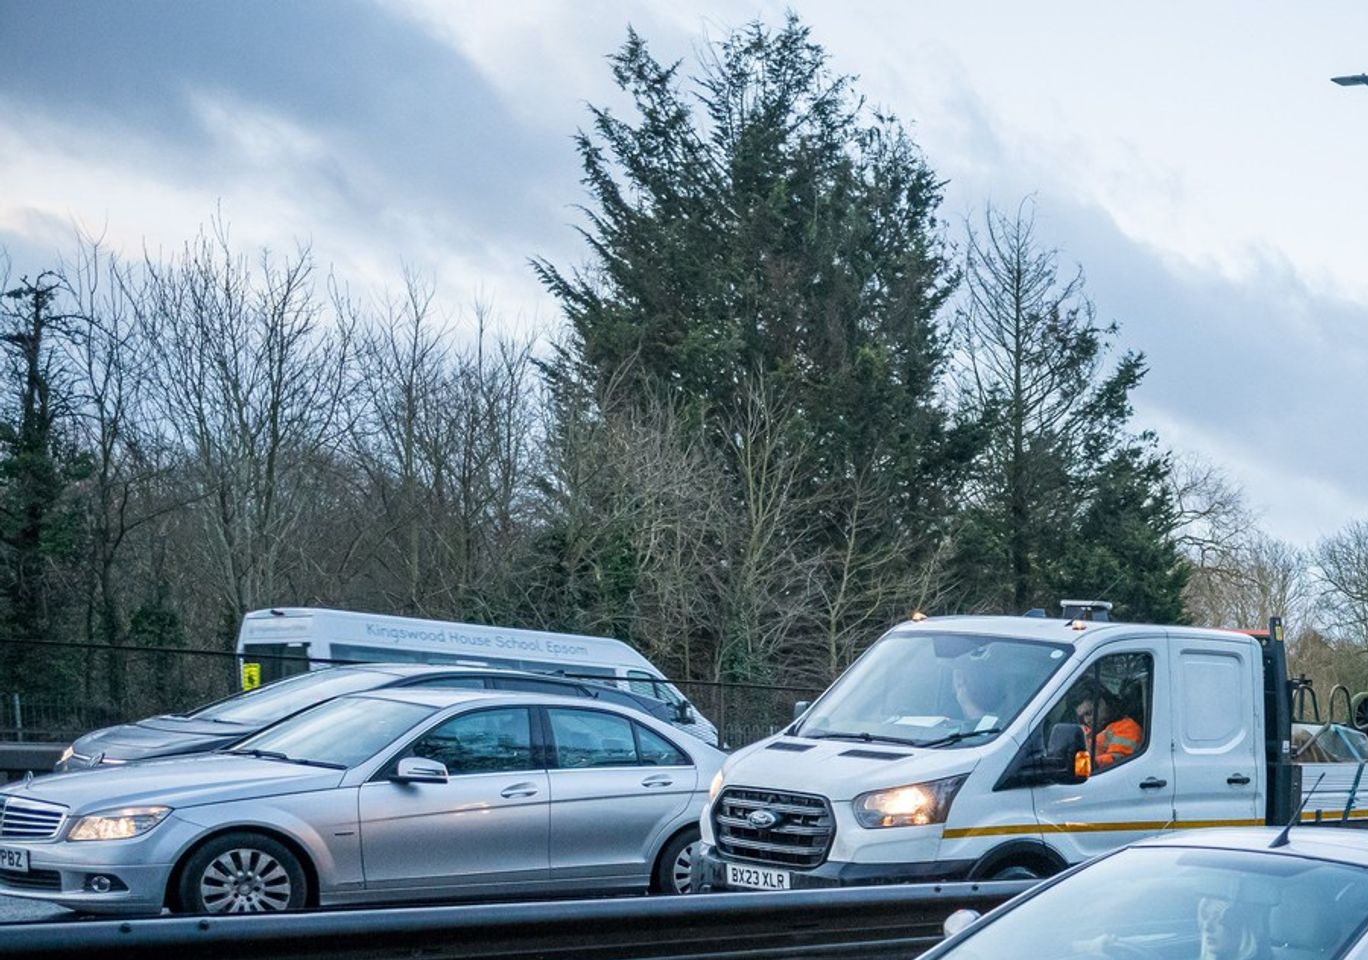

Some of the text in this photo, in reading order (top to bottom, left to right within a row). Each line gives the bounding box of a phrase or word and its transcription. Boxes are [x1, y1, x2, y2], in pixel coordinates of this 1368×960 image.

[366, 622, 446, 644] Kingswood
[449, 631, 491, 648] House
[545, 640, 588, 655] Epsom
[731, 868, 784, 888] BX23 XLR
